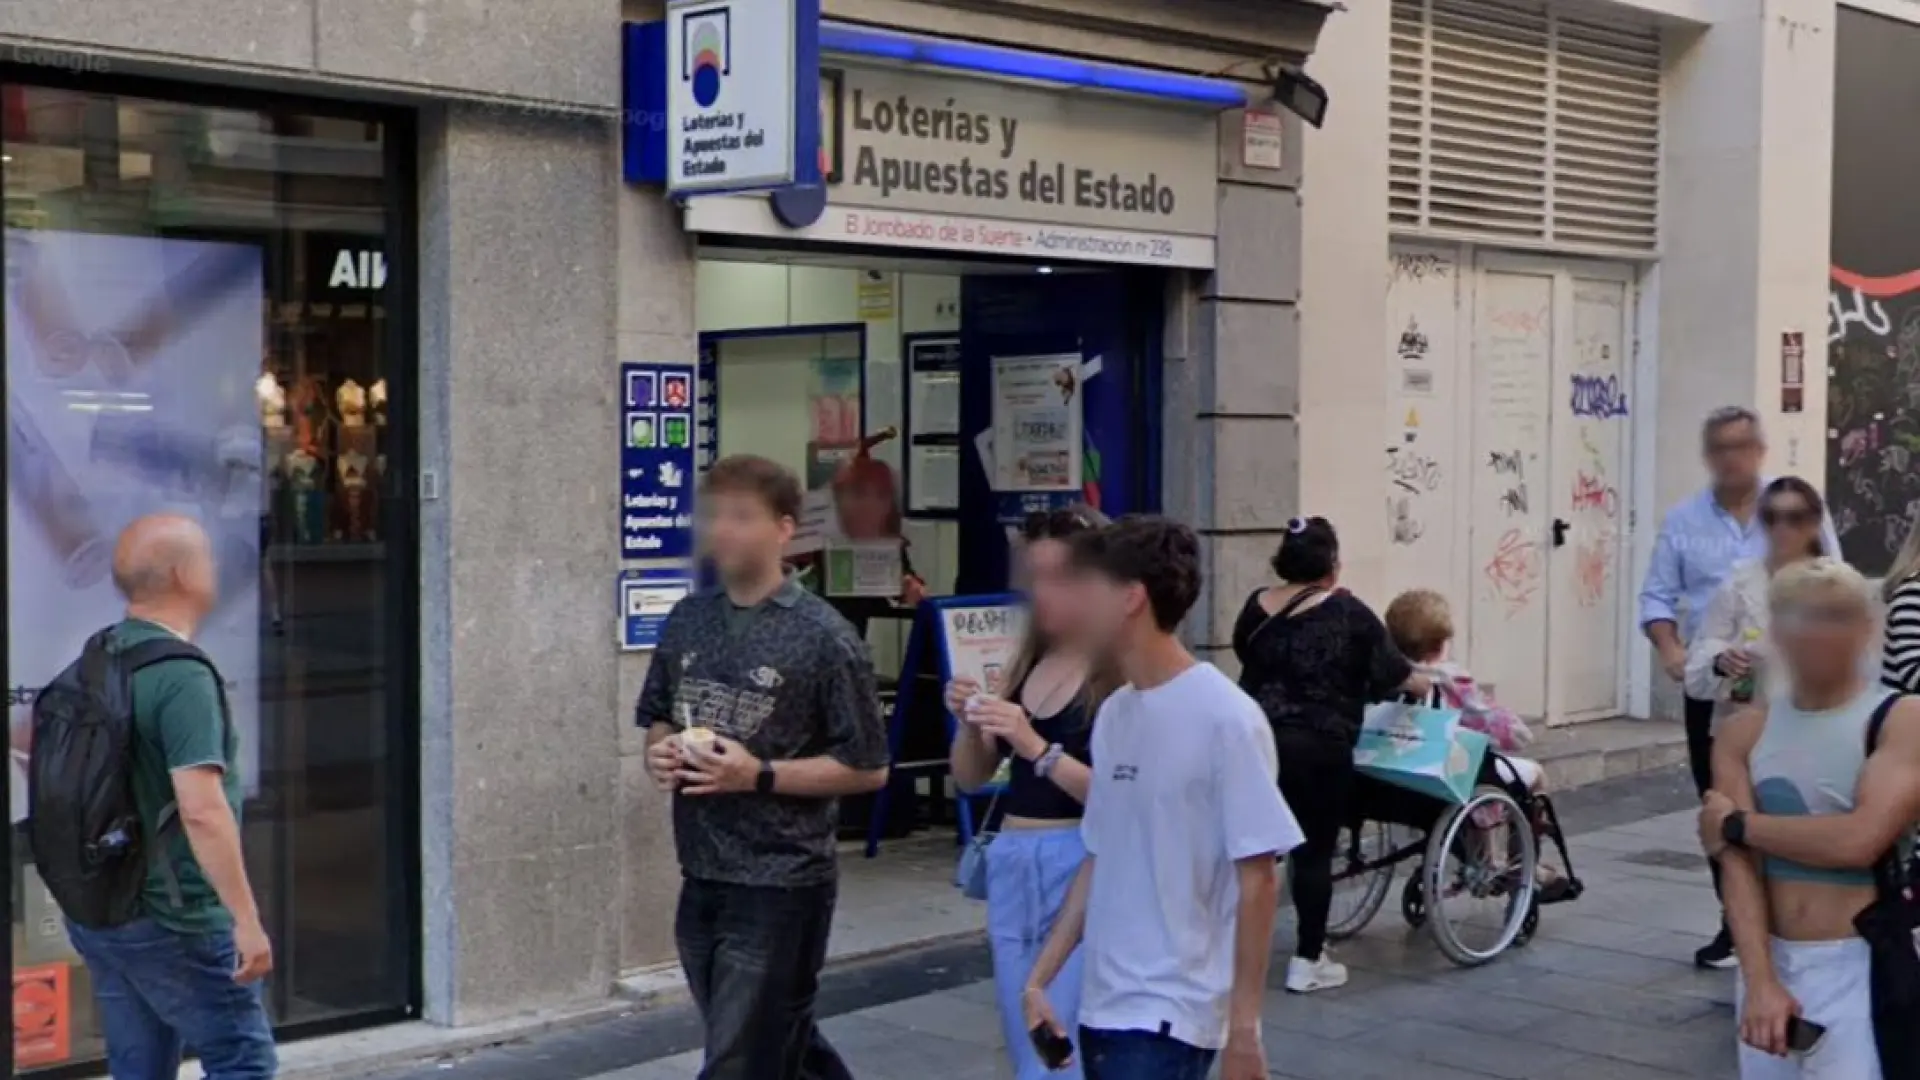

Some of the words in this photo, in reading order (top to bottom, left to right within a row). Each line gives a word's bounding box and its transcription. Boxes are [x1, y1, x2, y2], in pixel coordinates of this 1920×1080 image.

[853, 89, 990, 144] Loterías
[1001, 116, 1018, 158] y
[683, 135, 741, 157] Apuestas
[744, 128, 764, 149] del
[683, 157, 726, 177] Estado
[854, 145, 1009, 199] Apuestas
[1019, 159, 1065, 205] del
[1074, 168, 1175, 215] Estado
[863, 216, 933, 241] Jorobado
[938, 221, 957, 242] de
[962, 226, 975, 244] la
[978, 224, 1022, 248] Suerte
[1036, 229, 1132, 255] Administración
[625, 534, 663, 550] Estado
